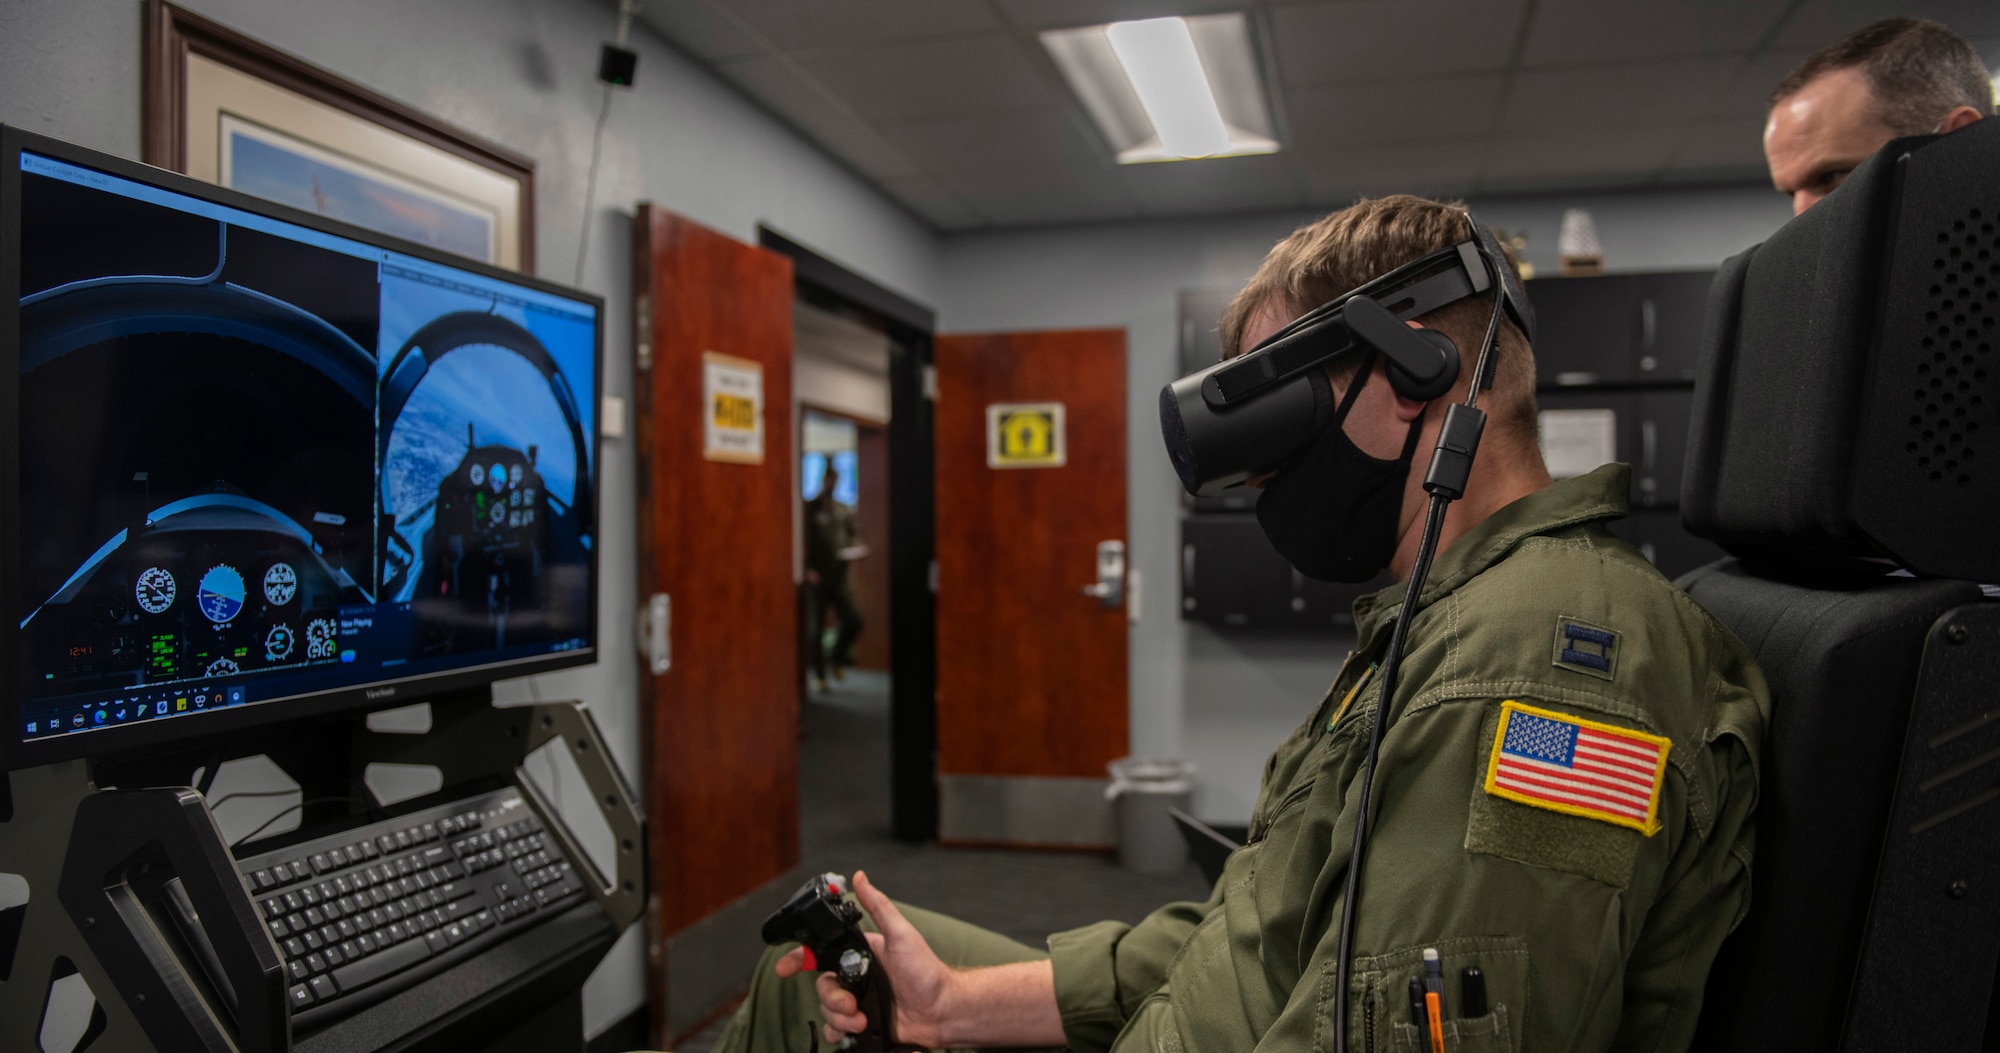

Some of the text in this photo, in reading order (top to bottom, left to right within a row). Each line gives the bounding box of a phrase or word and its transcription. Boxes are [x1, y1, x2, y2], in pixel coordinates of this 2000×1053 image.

[34, 161, 51, 172] Virtual
[53, 166, 72, 177] Cockpit
[73, 170, 86, 181] Only
[90, 175, 102, 184] View
[341, 617, 372, 628] Now Playing
[69, 646, 92, 657] 12:41
